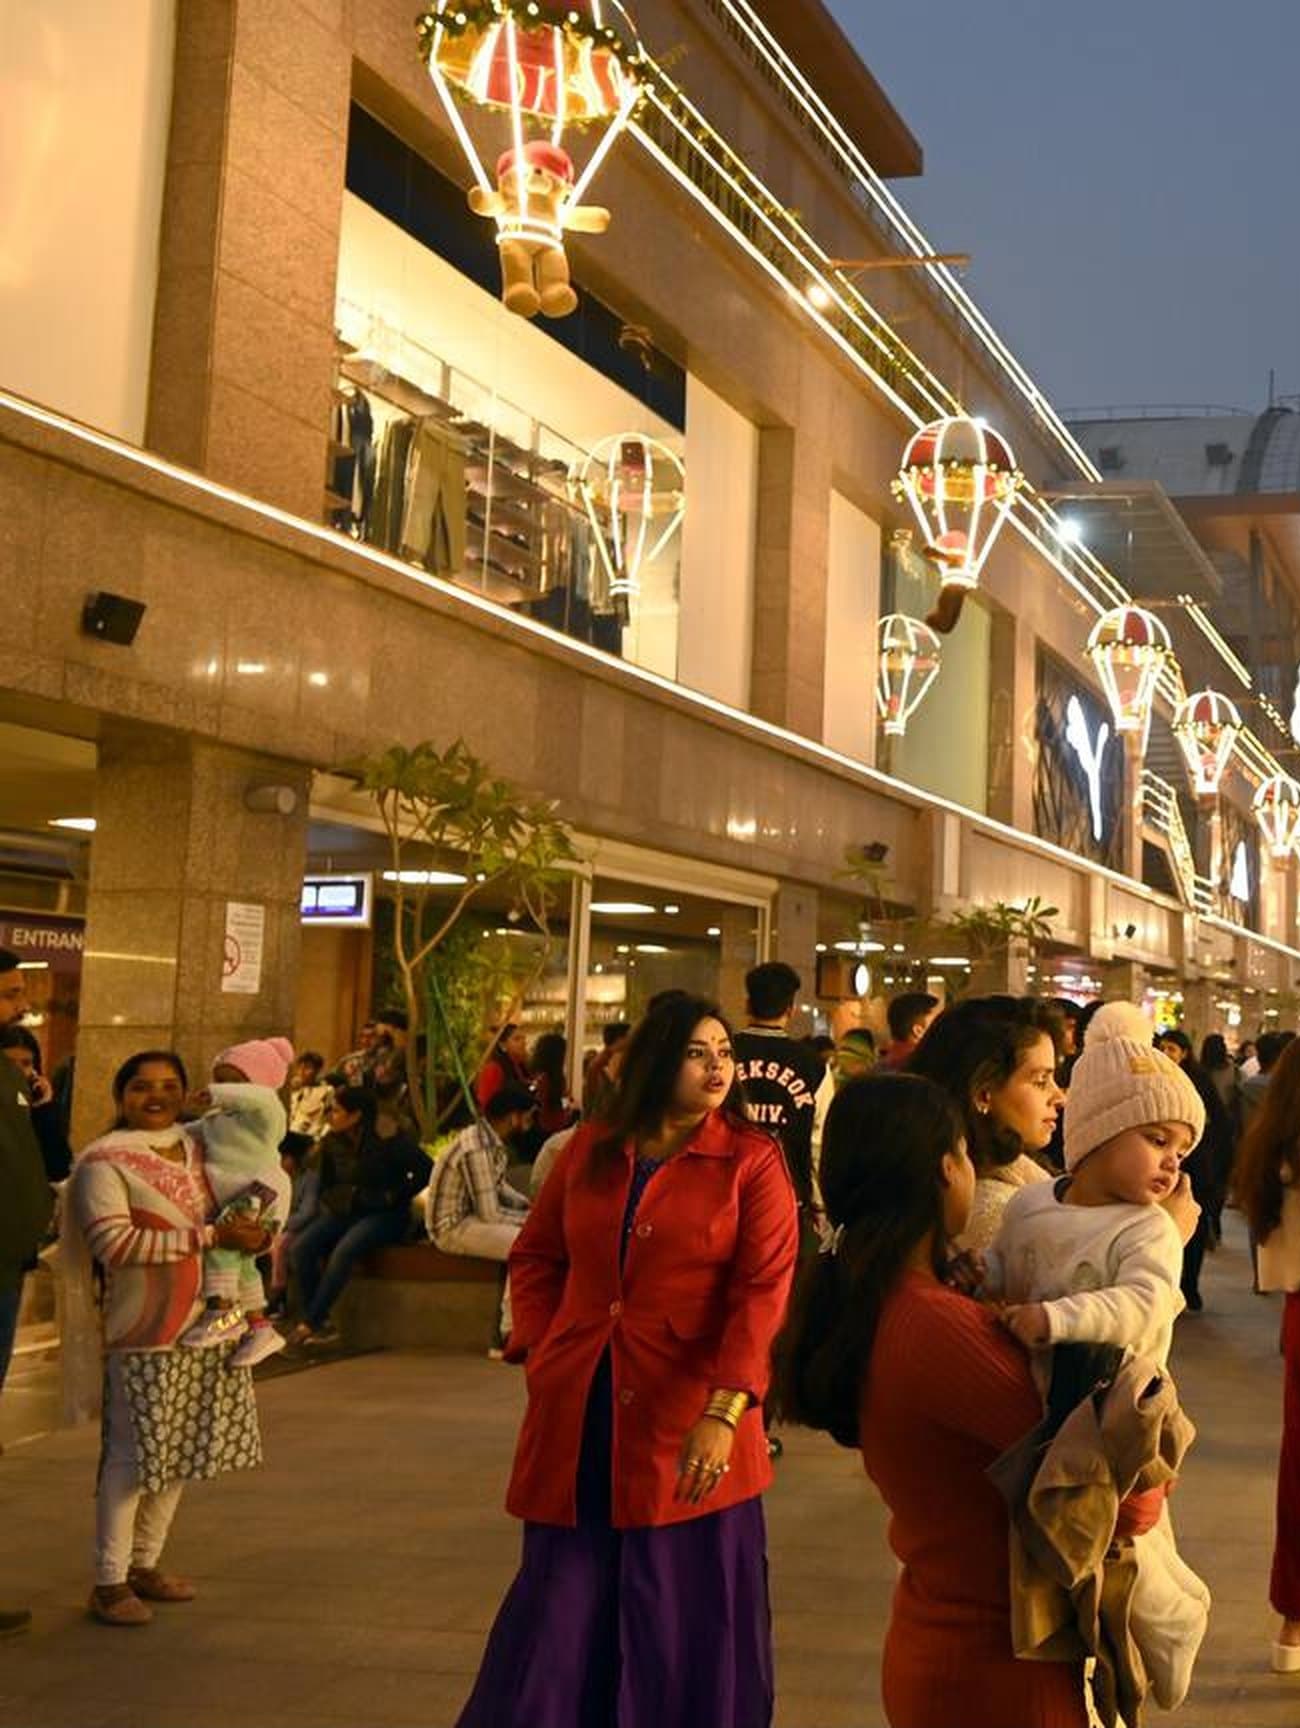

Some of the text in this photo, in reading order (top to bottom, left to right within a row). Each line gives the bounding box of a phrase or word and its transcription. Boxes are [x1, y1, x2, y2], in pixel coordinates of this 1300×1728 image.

[12, 927, 83, 950] ENTRAN
[736, 1060, 814, 1109] EKSEOK
[745, 1103, 787, 1124] NIV.
